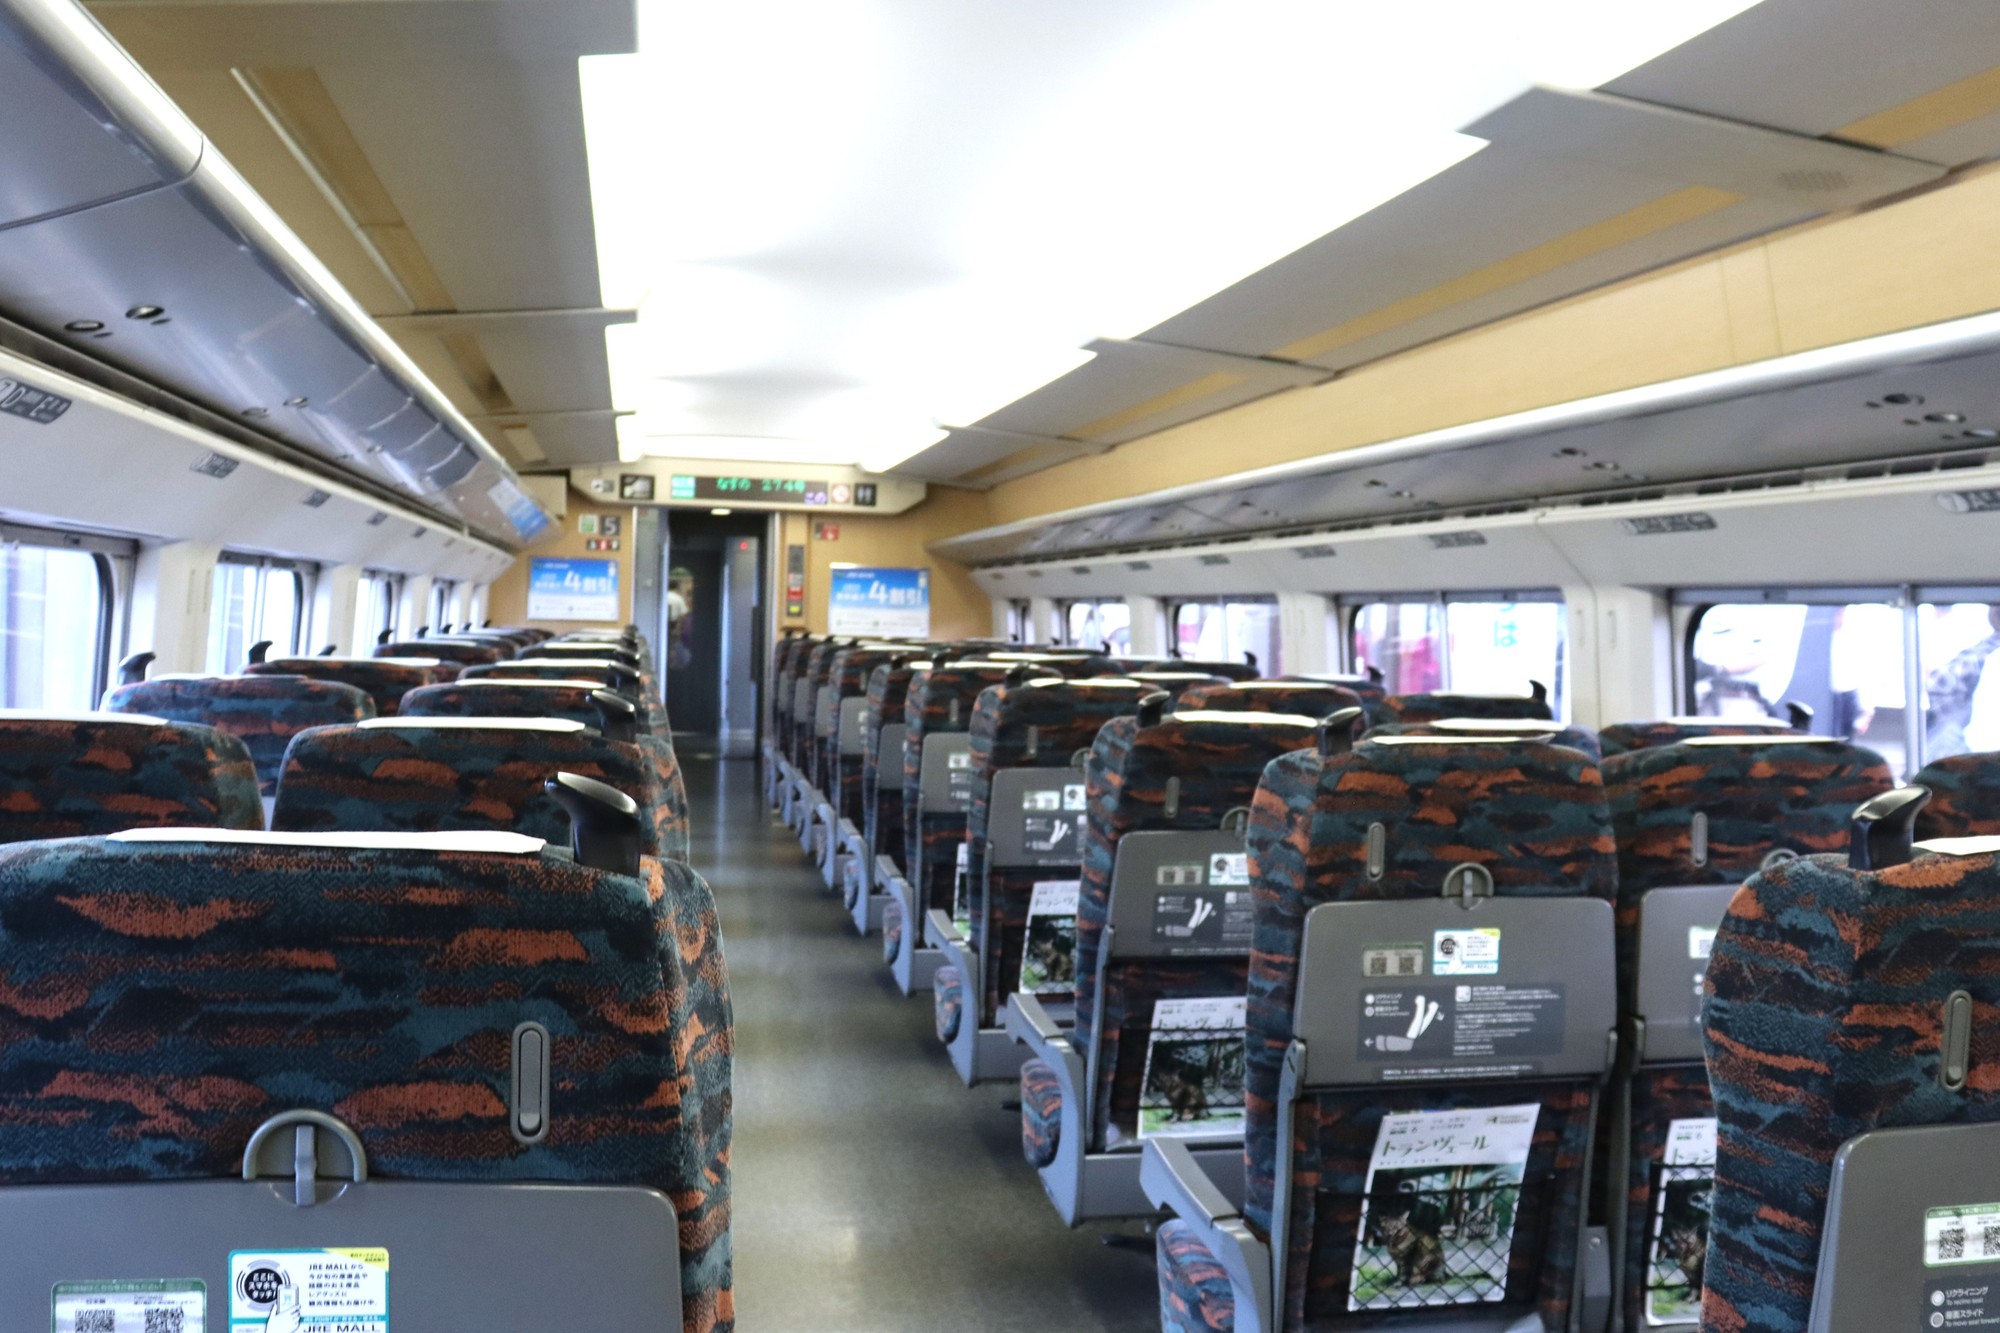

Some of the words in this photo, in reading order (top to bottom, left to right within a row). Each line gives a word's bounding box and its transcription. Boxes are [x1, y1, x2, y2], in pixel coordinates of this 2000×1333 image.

[605, 517, 617, 535] 5
[1382, 1135, 1489, 1157] トランヴェール
[1946, 1286, 1989, 1298] リクライニング
[304, 1325, 331, 1333] JRE
[337, 1324, 380, 1333] MALL
